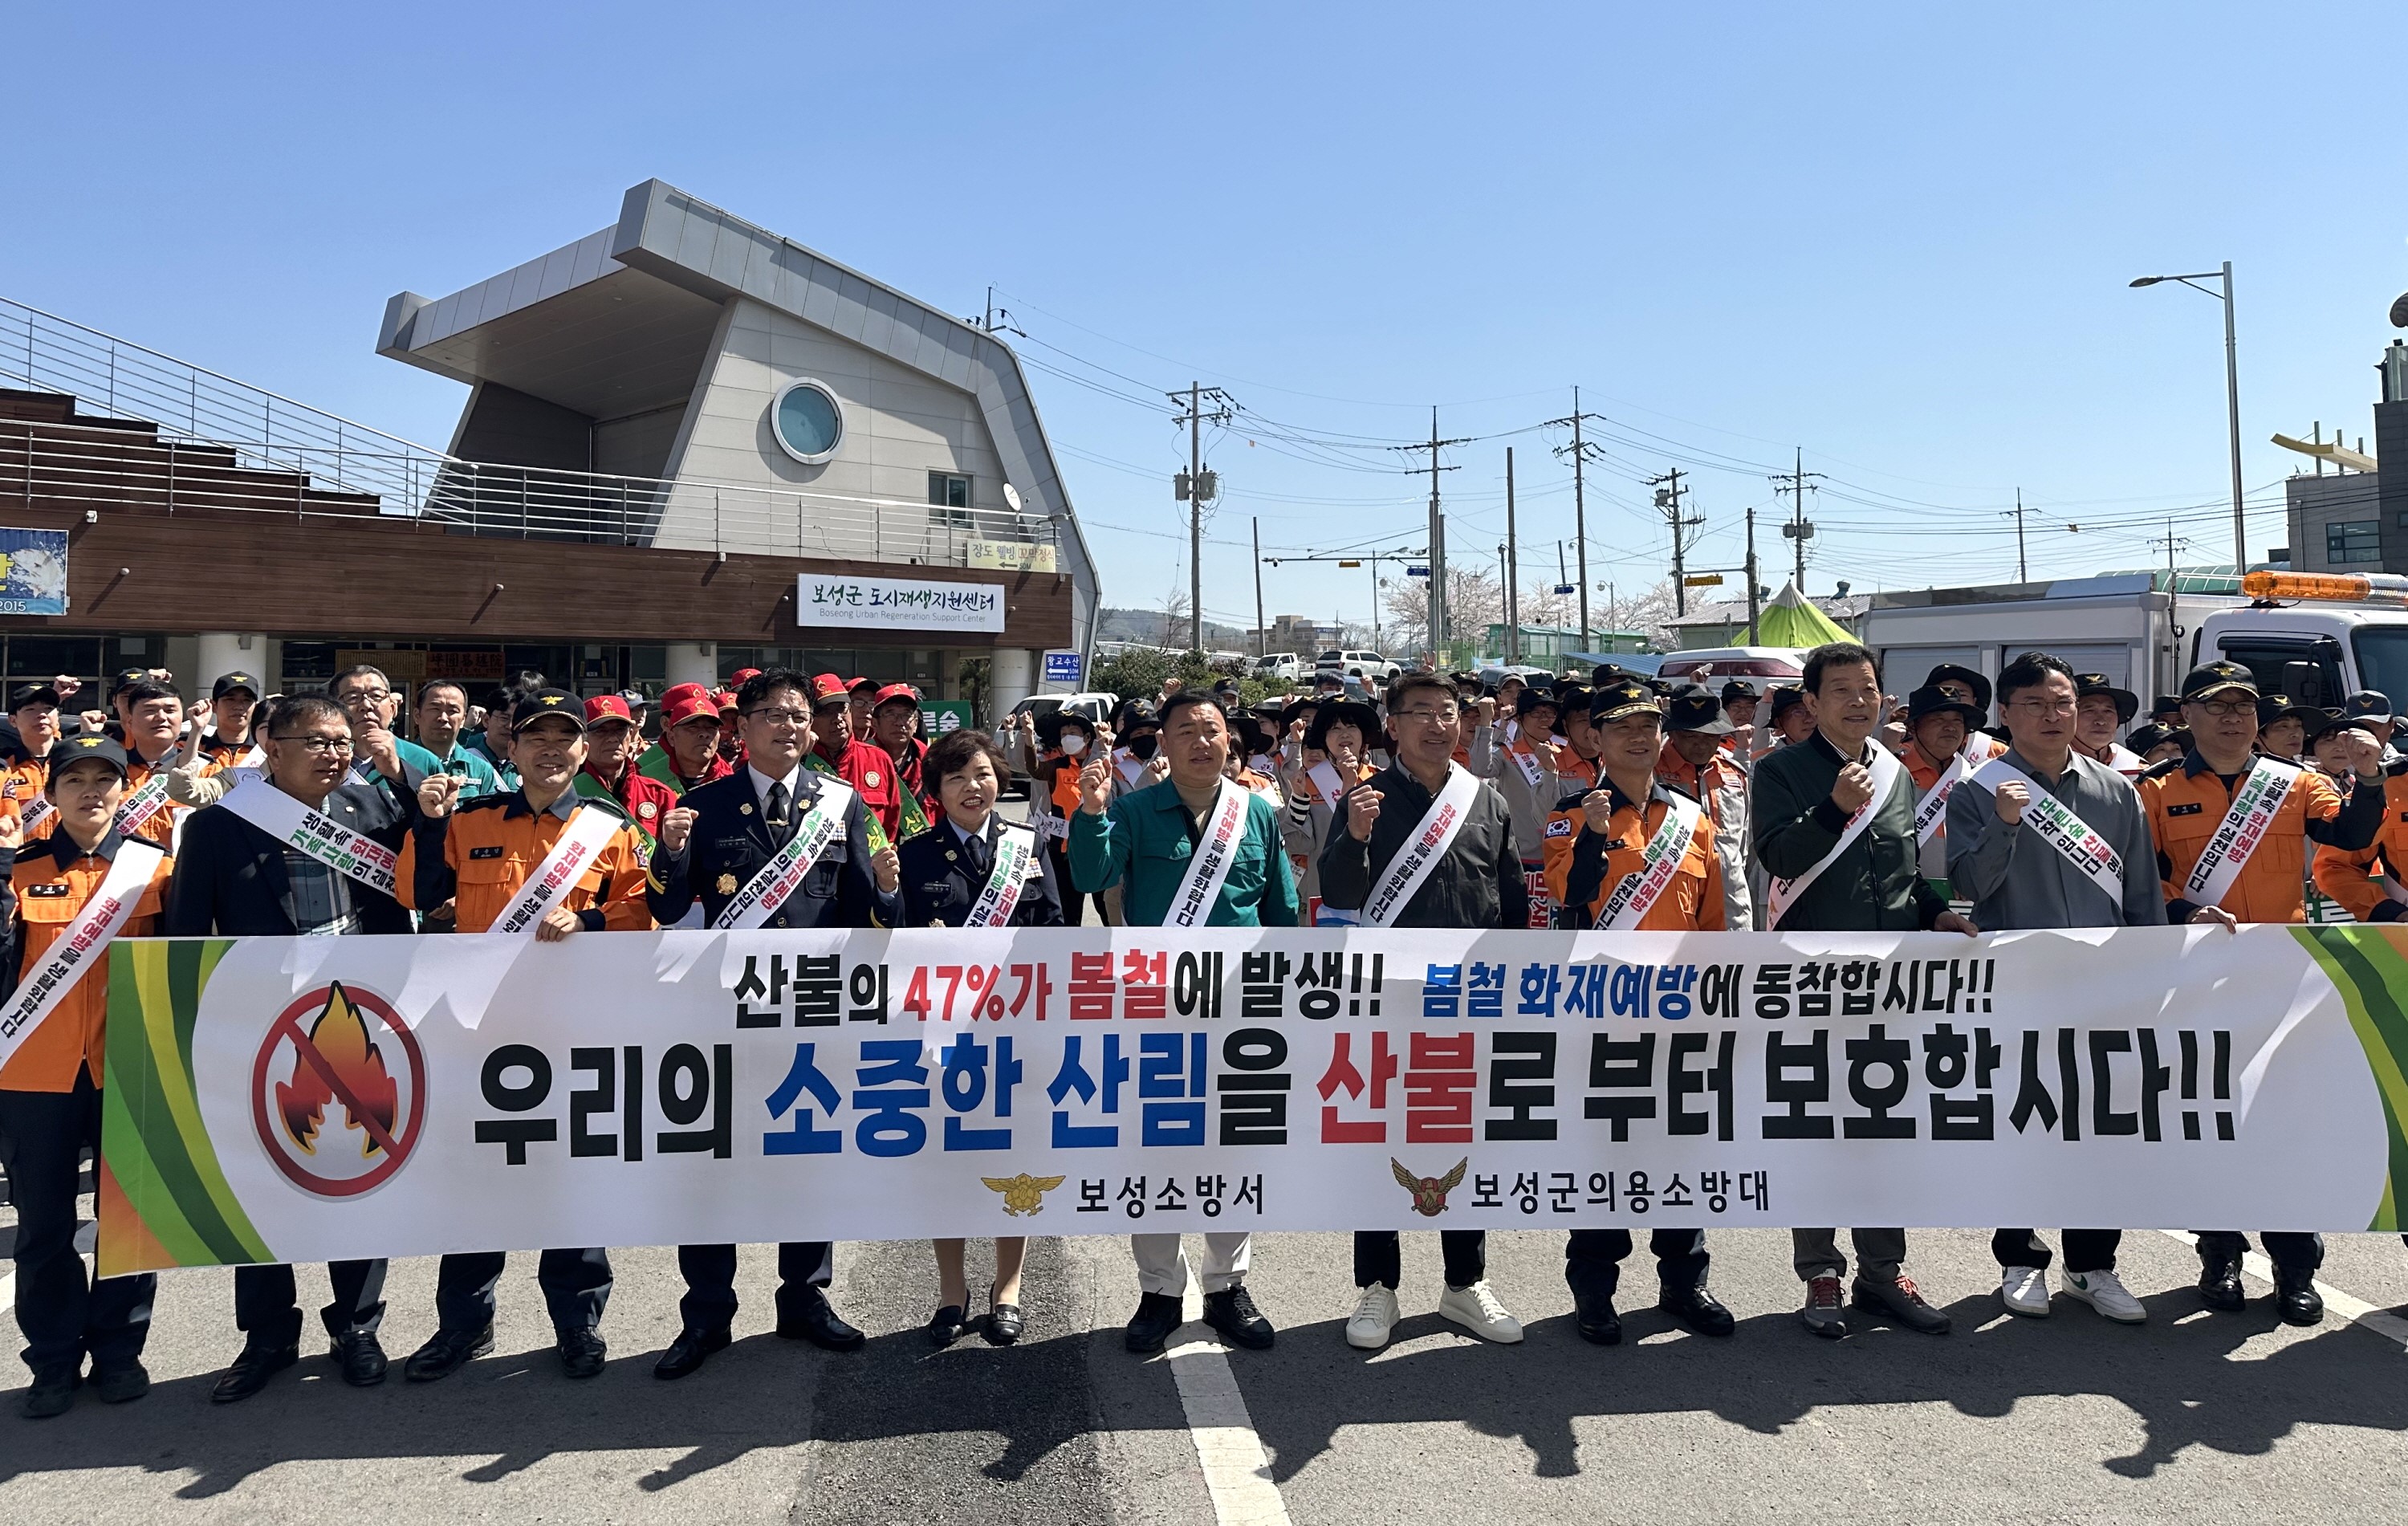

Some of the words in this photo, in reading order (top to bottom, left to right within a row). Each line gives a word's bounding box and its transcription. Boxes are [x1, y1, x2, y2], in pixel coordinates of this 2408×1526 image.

[972, 543, 993, 558] 장도
[997, 546, 1015, 560] 웰빙
[812, 584, 863, 606] 보성군
[868, 588, 995, 611] 도시재생지원센터
[820, 608, 853, 618] Boseong
[856, 609, 879, 619] Urban
[881, 611, 929, 621] Regeneration
[933, 612, 960, 623] Support
[962, 614, 986, 623] Center
[128, 775, 169, 811] 족사랑의
[2037, 797, 2087, 840] 푸른숲
[2226, 768, 2272, 828] 가족사랑의
[2259, 776, 2290, 814] 생활속
[302, 812, 352, 845] 생활속
[773, 810, 823, 872] 가족사랑의
[808, 817, 835, 859] 생활속
[1211, 796, 1240, 855] 화재예방을
[1414, 803, 1457, 859] 화재예방을
[1668, 824, 1690, 863] 생활속
[2027, 808, 2060, 836] 시작
[2056, 834, 2102, 876] 입니다
[2227, 811, 2268, 864] 화재예방
[289, 828, 372, 879] 가족사랑의
[534, 840, 587, 901] 화재예방을
[982, 840, 1014, 905] 가족사랑의
[1011, 844, 1030, 885] 생활속
[2188, 826, 2237, 893] 실천입니다
[761, 856, 810, 910] 화재예방
[1176, 853, 1222, 927] 생활화합시다
[1370, 855, 1423, 923] 생활화합시다
[1629, 859, 1674, 913] 화재예방
[59, 897, 121, 966] 화재예방을
[1, 962, 69, 1038] 생활화합시다
[734, 953, 889, 1028] 산불의
[904, 962, 1051, 1023] 47%가
[1068, 950, 1222, 1020] 봄철에
[1239, 950, 1383, 1020] 발생!!
[1422, 962, 1507, 1018] 봄철
[1517, 962, 1739, 1020] 화재예방에
[1752, 959, 1995, 1019] 동참합시다!!
[474, 1044, 732, 1165] 우리의
[763, 1032, 1023, 1158] 소중한
[1046, 1027, 1291, 1149] 산림을
[1316, 1031, 1559, 1145] 산불로
[1584, 1031, 1735, 1141] 부터
[1762, 1023, 2235, 1142] 보호합시다!!
[1076, 1173, 1264, 1216] 보성소방서
[1470, 1169, 1769, 1214] 보성군의용소방대
